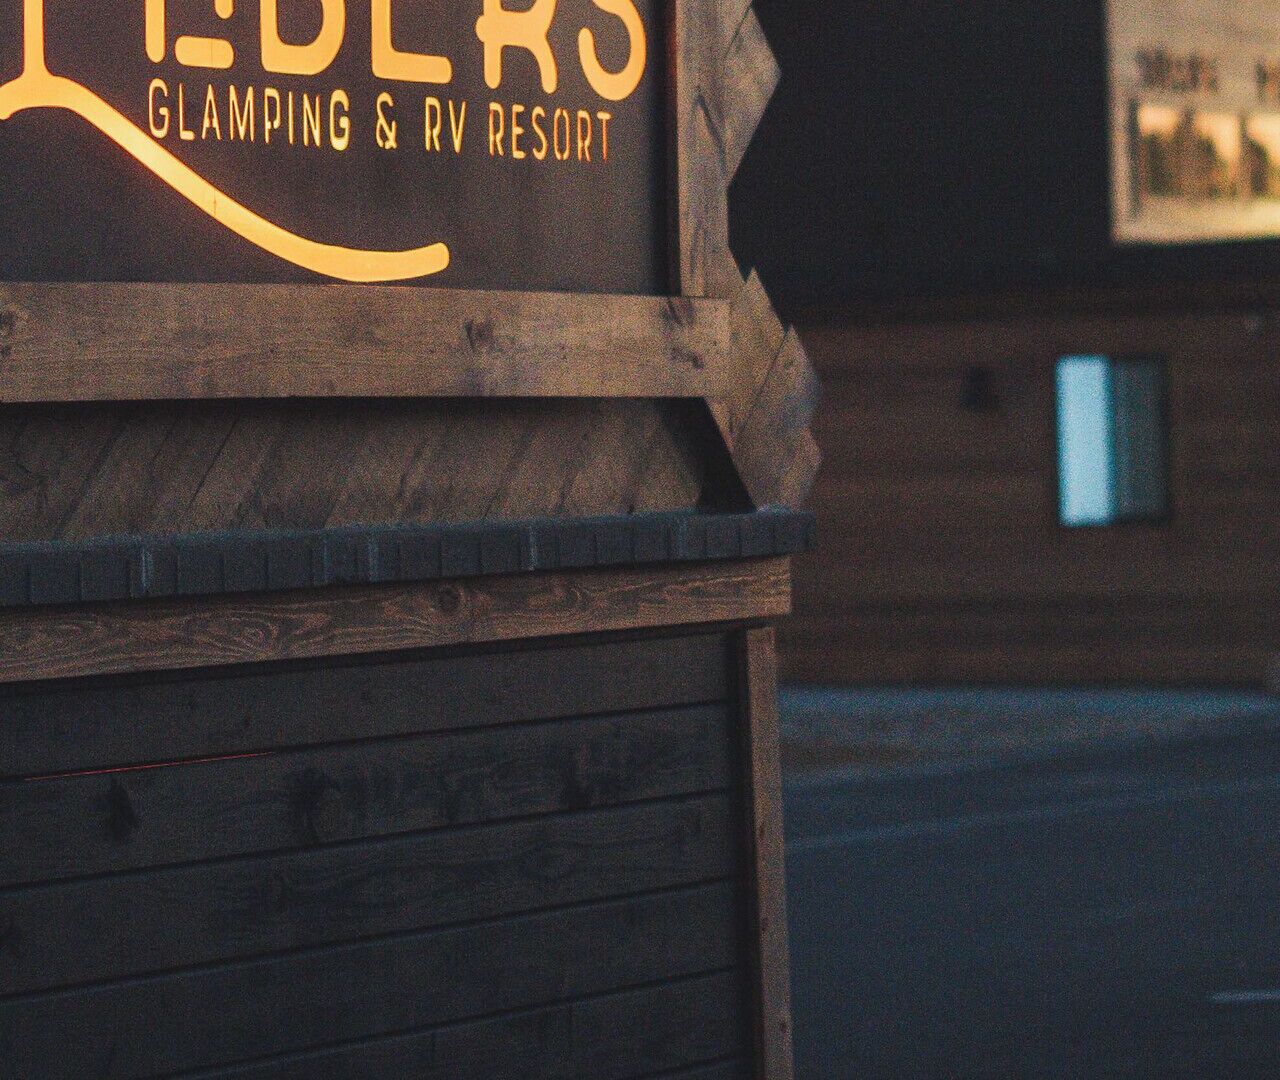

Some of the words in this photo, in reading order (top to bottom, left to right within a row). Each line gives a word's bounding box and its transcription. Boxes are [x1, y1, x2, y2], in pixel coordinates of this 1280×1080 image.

[148, 77, 352, 151] GLAMPING
[375, 91, 398, 151] &
[424, 96, 468, 154] RV
[488, 101, 613, 163] RESORT
